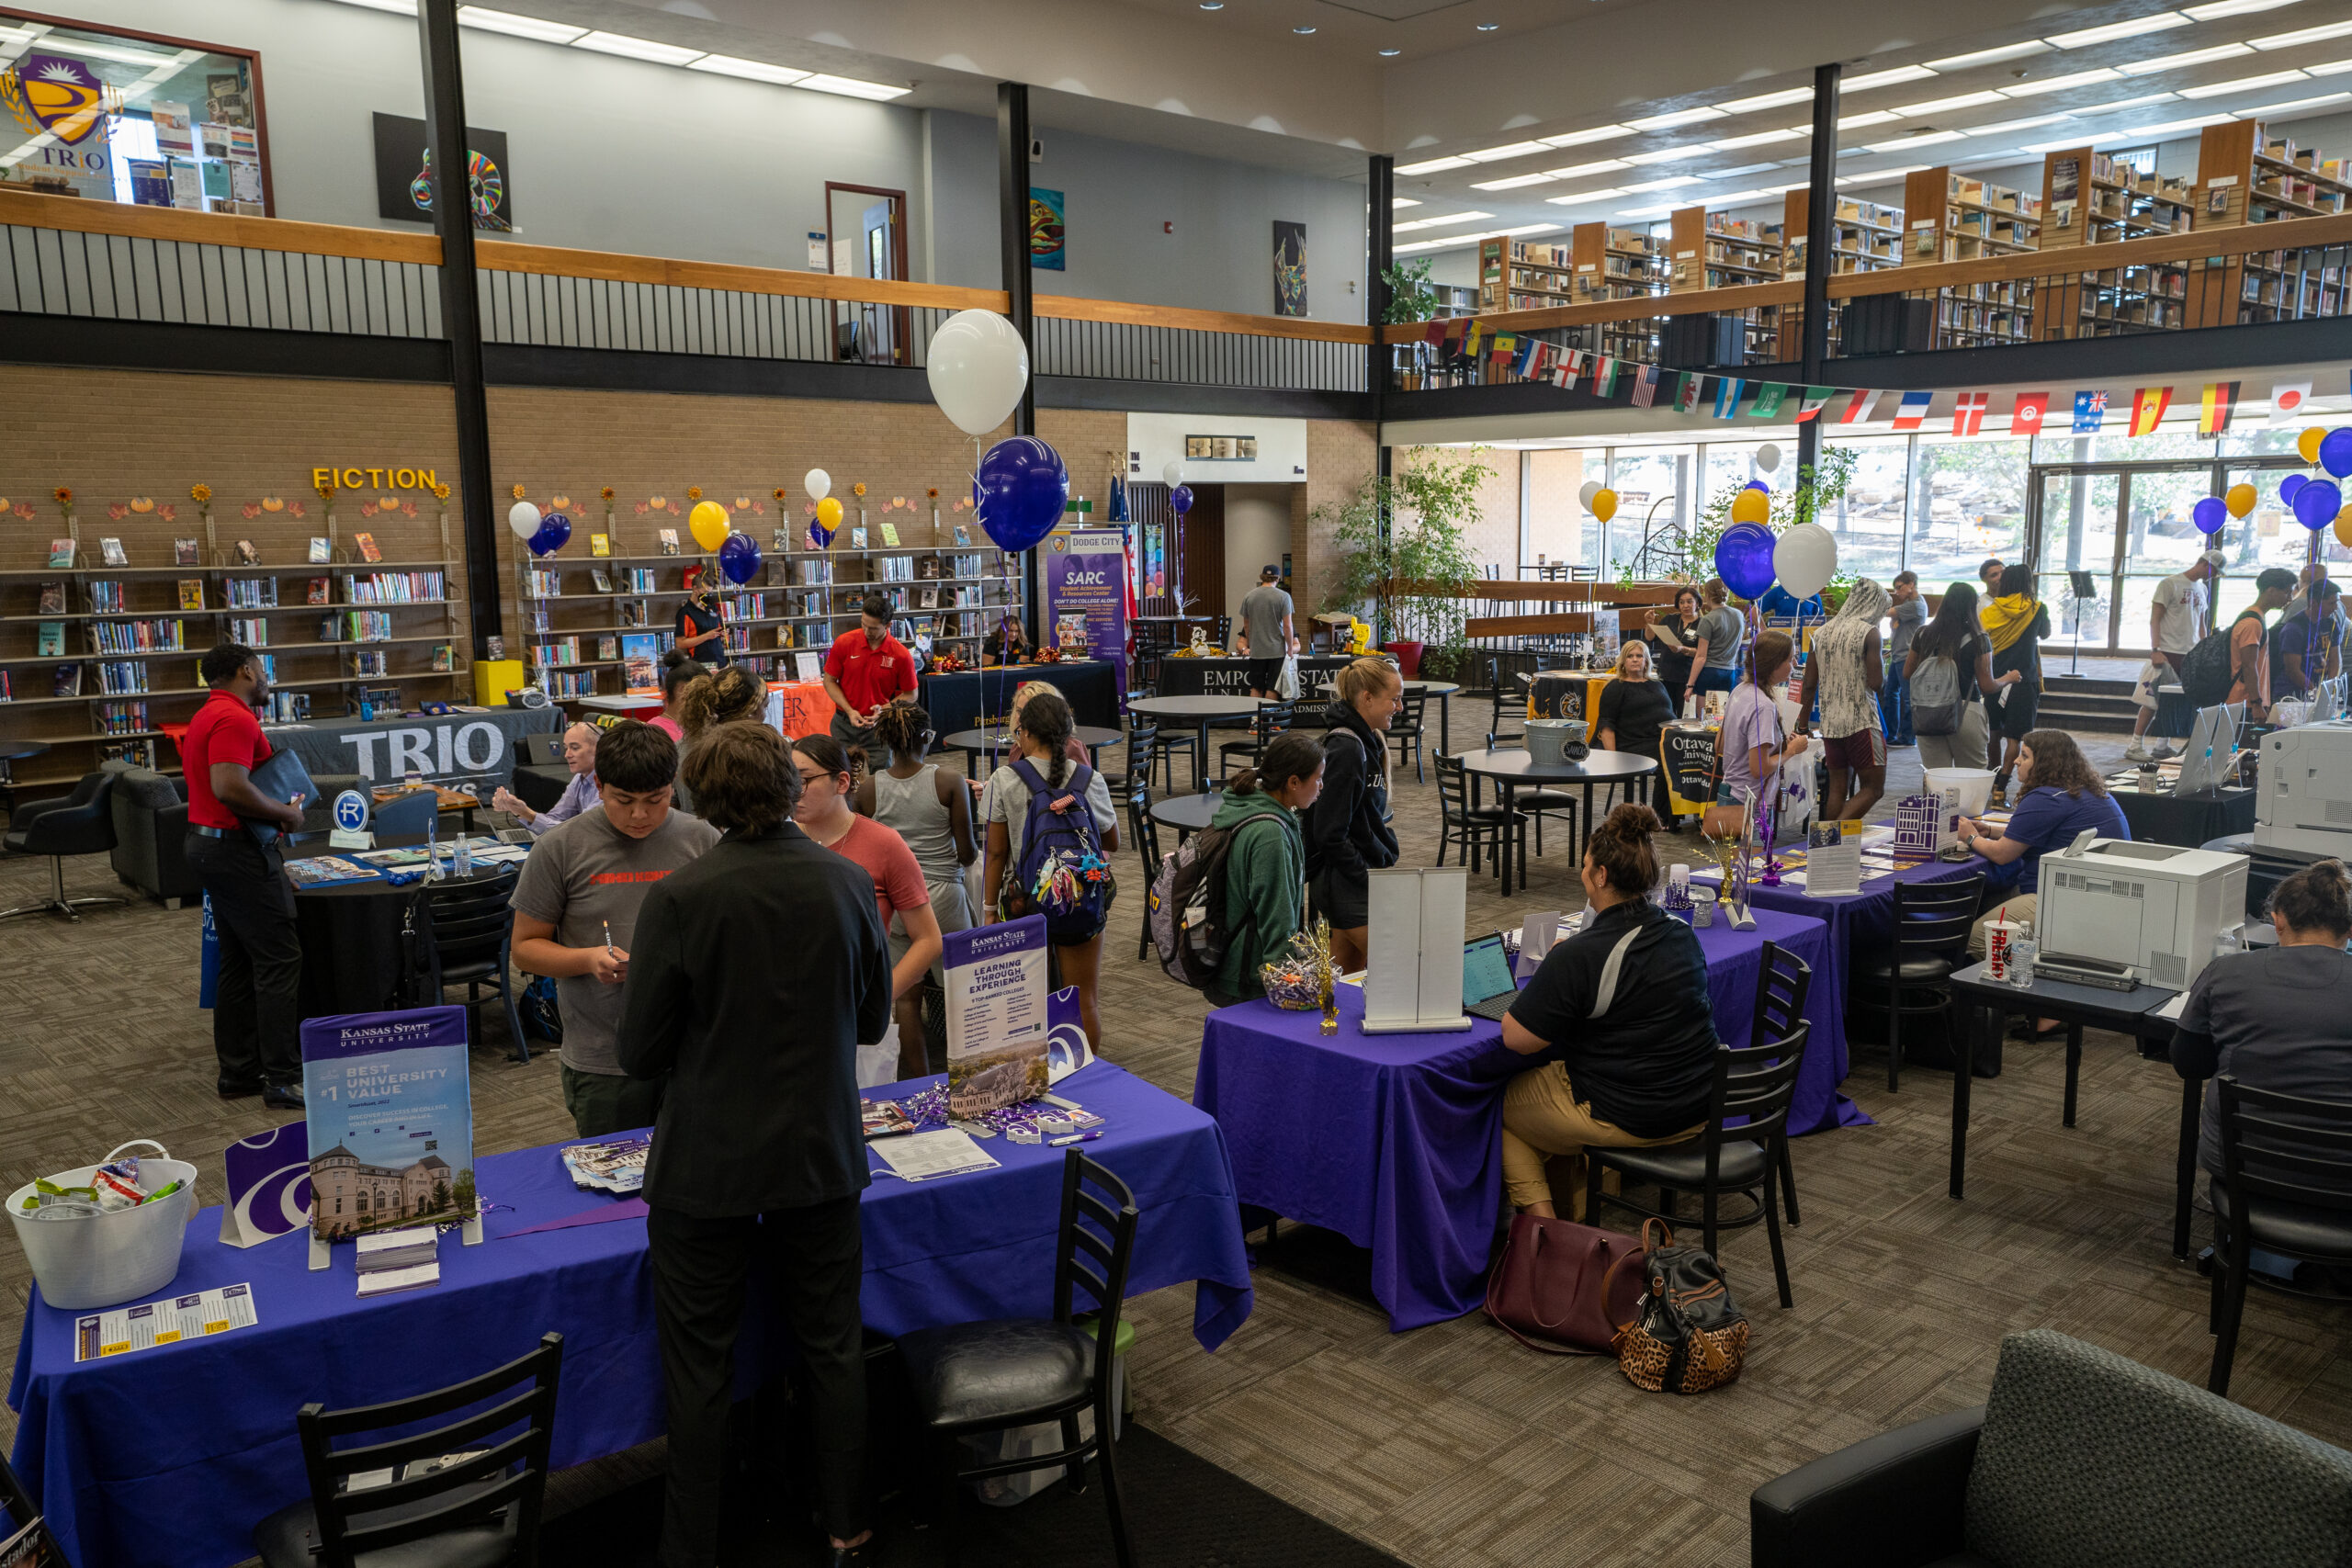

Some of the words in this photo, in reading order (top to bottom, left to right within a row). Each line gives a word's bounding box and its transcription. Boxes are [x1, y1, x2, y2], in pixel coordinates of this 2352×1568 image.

[312, 468, 436, 489] FICTION
[1073, 538, 1100, 547] DODGE
[1102, 537, 1120, 546] CITY
[1066, 571, 1105, 585] SARC
[1298, 669, 1342, 685] STAT
[974, 714, 1011, 728] Pttsbrg
[340, 722, 504, 781] TRIO
[971, 934, 1002, 948] KANSAS
[1003, 931, 1025, 942] STATE
[971, 939, 1026, 954] UNIVERSITY
[974, 959, 1022, 976] LEARNING
[975, 967, 1021, 984] THROUGH
[969, 974, 1026, 994] EXPERIENCE
[341, 1027, 390, 1039] KANSAS
[393, 1023, 430, 1034] STATE
[341, 1032, 430, 1047] UNIVERSITY
[346, 1065, 390, 1077] BEST
[346, 1067, 447, 1089] UNIVERSITY
[321, 1086, 337, 1101] #1
[347, 1085, 402, 1100] VALUE
[348, 1111, 381, 1121] DISCOVER
[382, 1108, 410, 1117] SUCCESS
